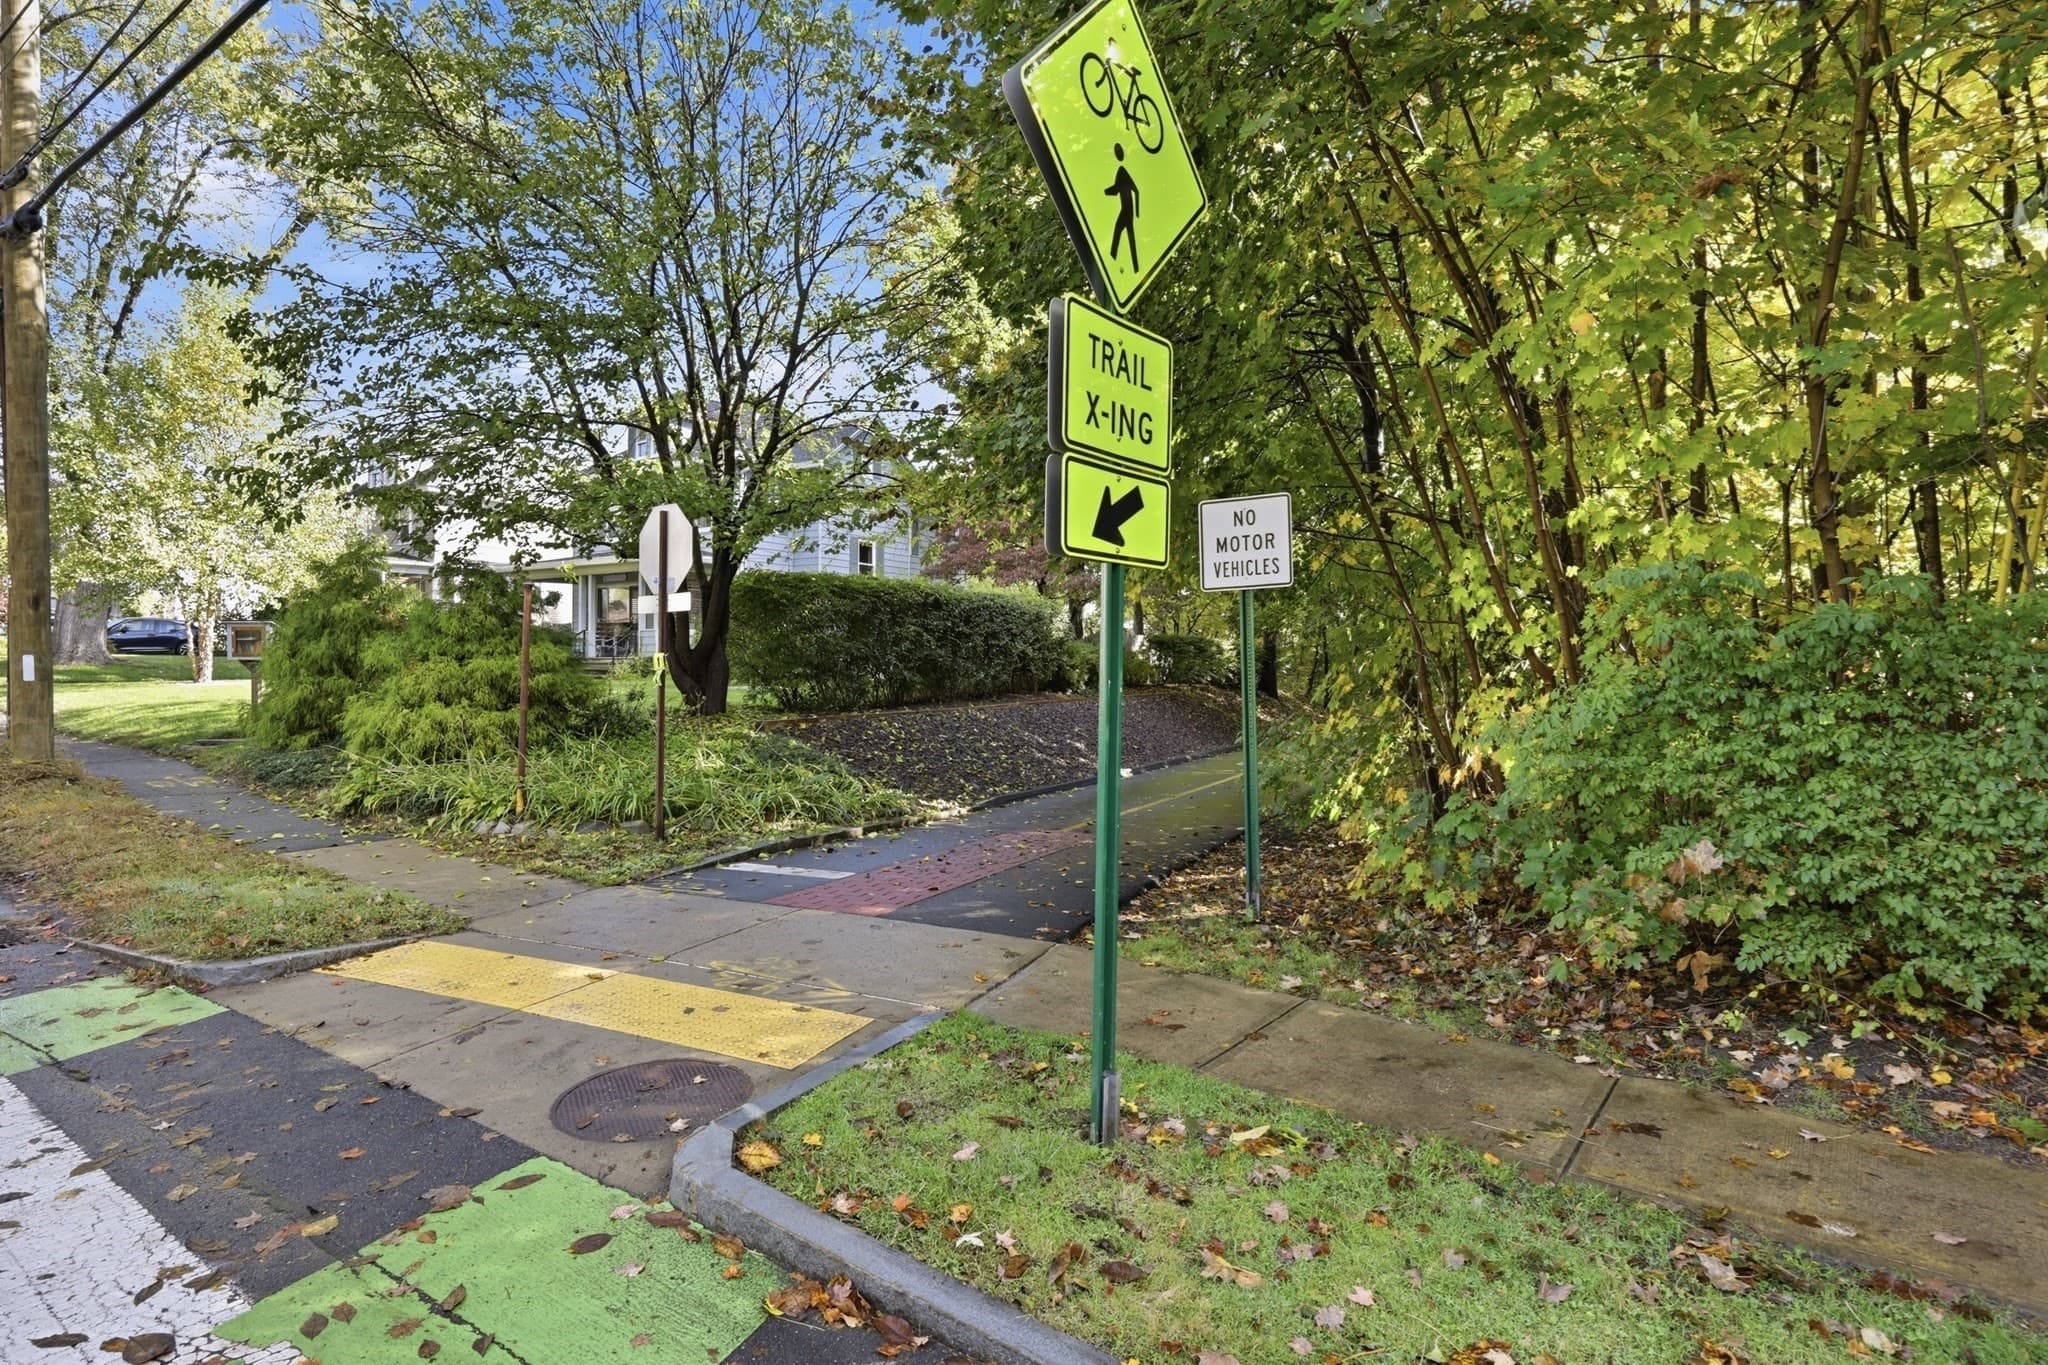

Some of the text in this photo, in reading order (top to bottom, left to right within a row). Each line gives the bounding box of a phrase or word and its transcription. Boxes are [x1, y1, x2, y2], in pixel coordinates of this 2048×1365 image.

[1088, 332, 1152, 392] TRAIL
[1085, 390, 1153, 445] X-ING
[1233, 509, 1256, 527] NO
[1216, 532, 1275, 553] MOTOR
[1213, 557, 1280, 579] VEHICLES
